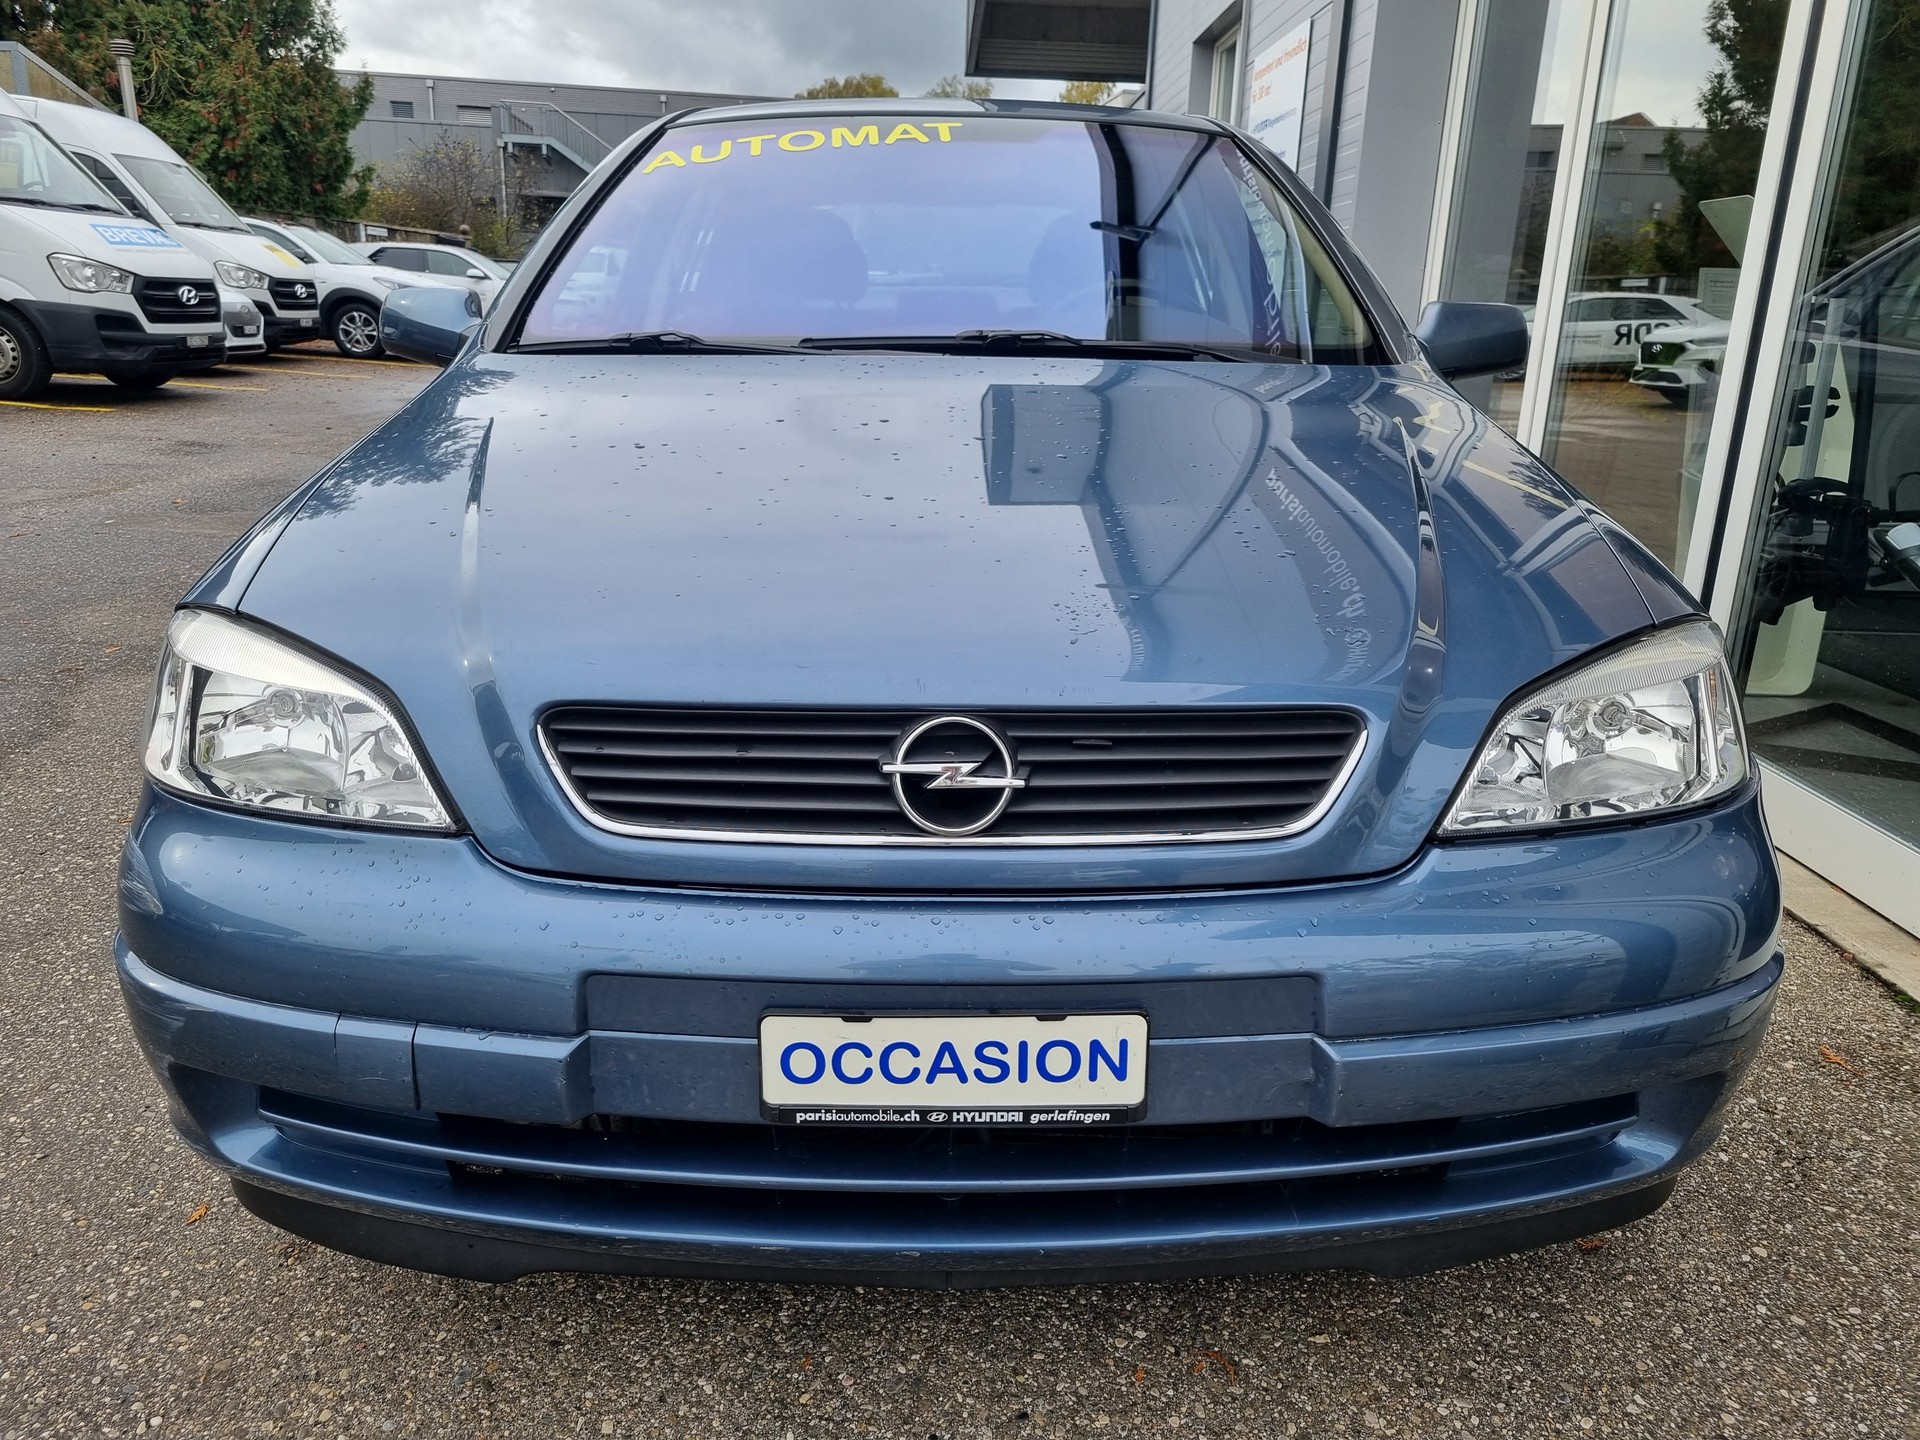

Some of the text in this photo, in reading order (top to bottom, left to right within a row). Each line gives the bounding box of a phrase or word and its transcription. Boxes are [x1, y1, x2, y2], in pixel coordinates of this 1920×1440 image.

[643, 122, 963, 175] AUTOMAT
[780, 1038, 1129, 1085] OCCASION
[796, 1109, 1111, 1124] parisiautomobile.ch HYUNDAI gerlafingen
